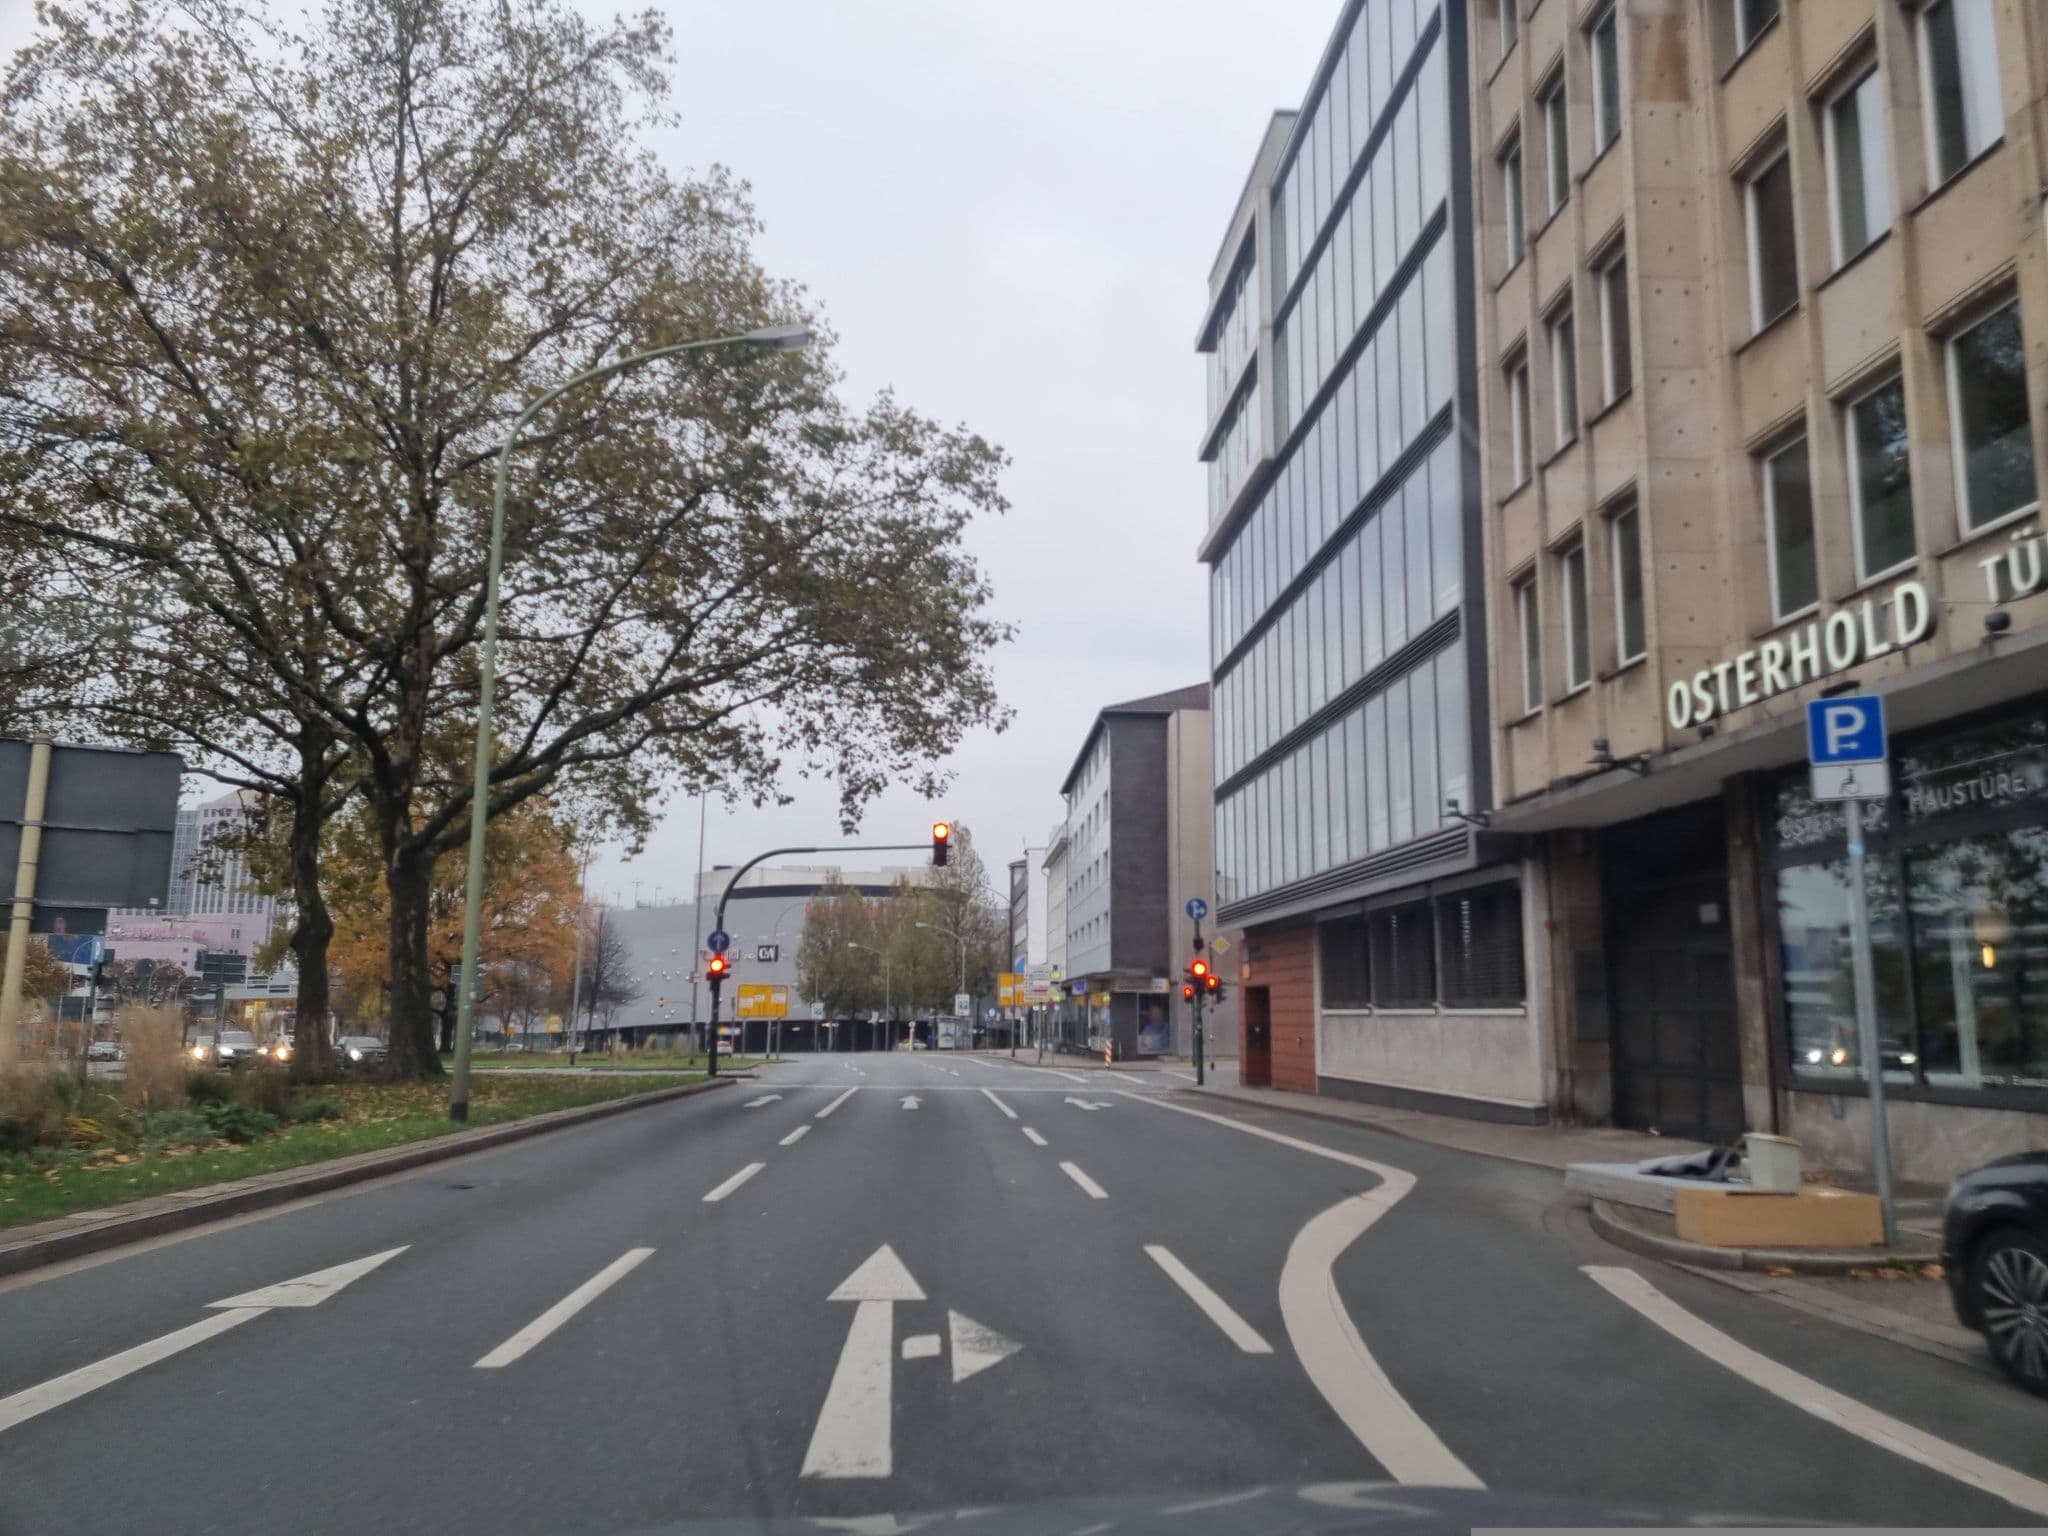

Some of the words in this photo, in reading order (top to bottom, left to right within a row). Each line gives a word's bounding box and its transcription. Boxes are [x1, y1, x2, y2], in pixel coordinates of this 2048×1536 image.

[1667, 581, 1933, 730] OSTERHOLD
[1976, 526, 2048, 604] TÜ
[1824, 705, 1867, 755] P
